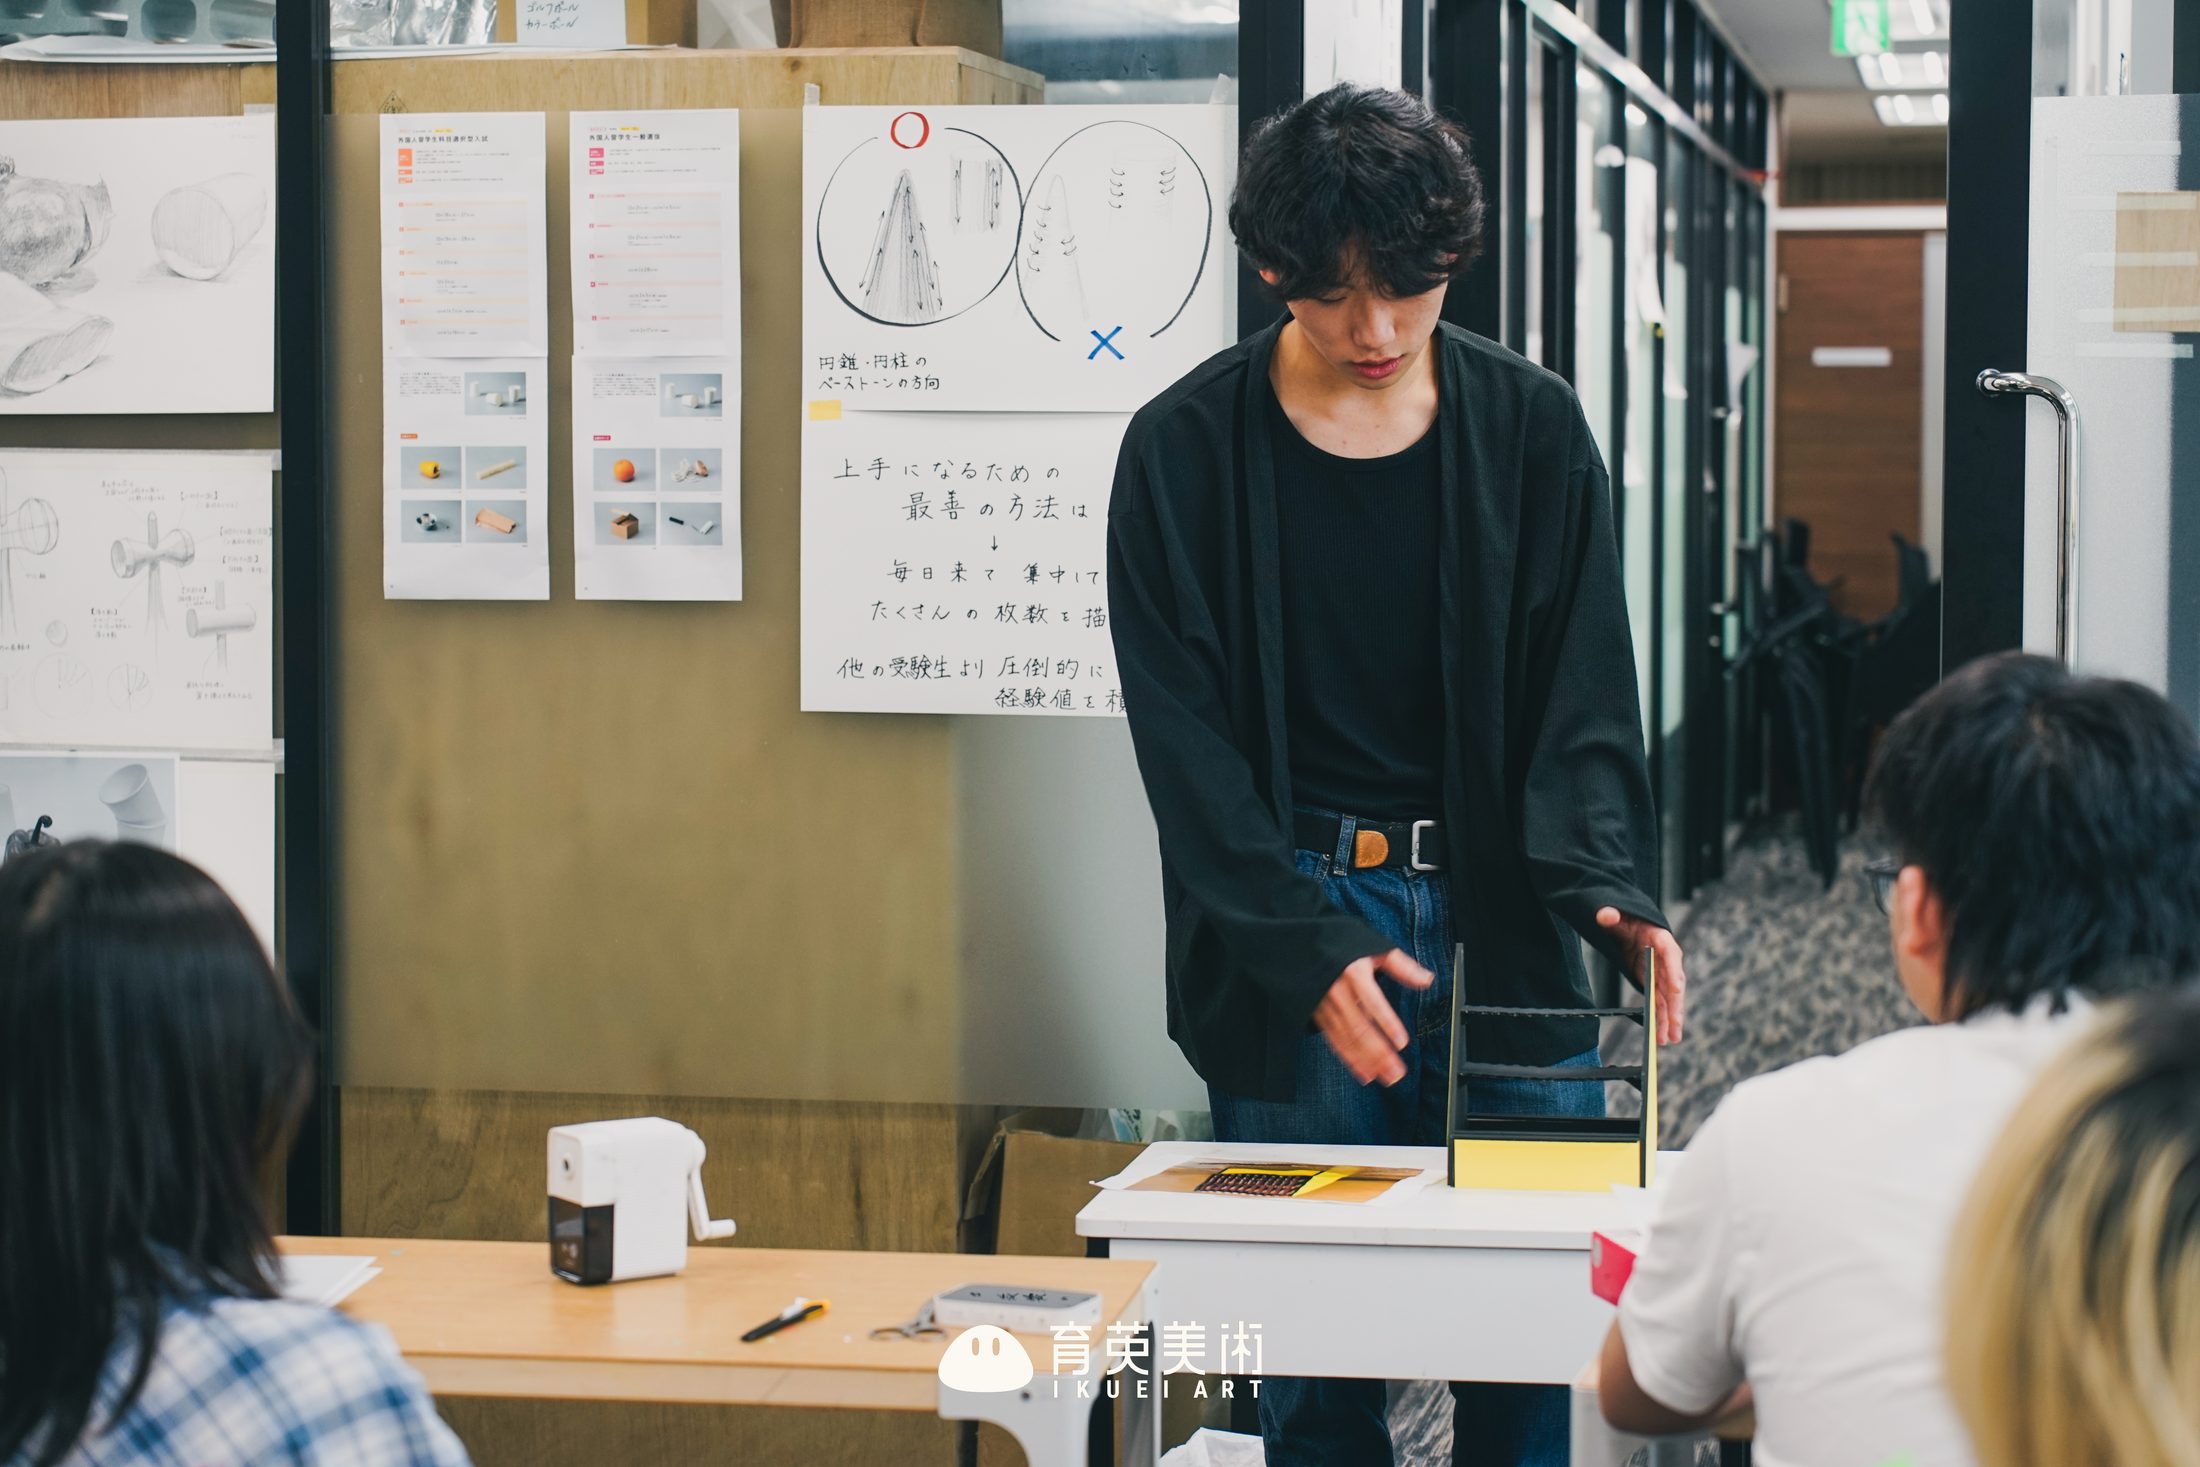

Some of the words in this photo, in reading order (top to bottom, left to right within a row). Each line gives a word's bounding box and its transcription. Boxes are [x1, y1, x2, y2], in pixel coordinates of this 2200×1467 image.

[818, 373, 940, 390] ベーストーンの方向
[833, 456, 1060, 483] 上手になるための
[901, 489, 1089, 521] 最善の方法は
